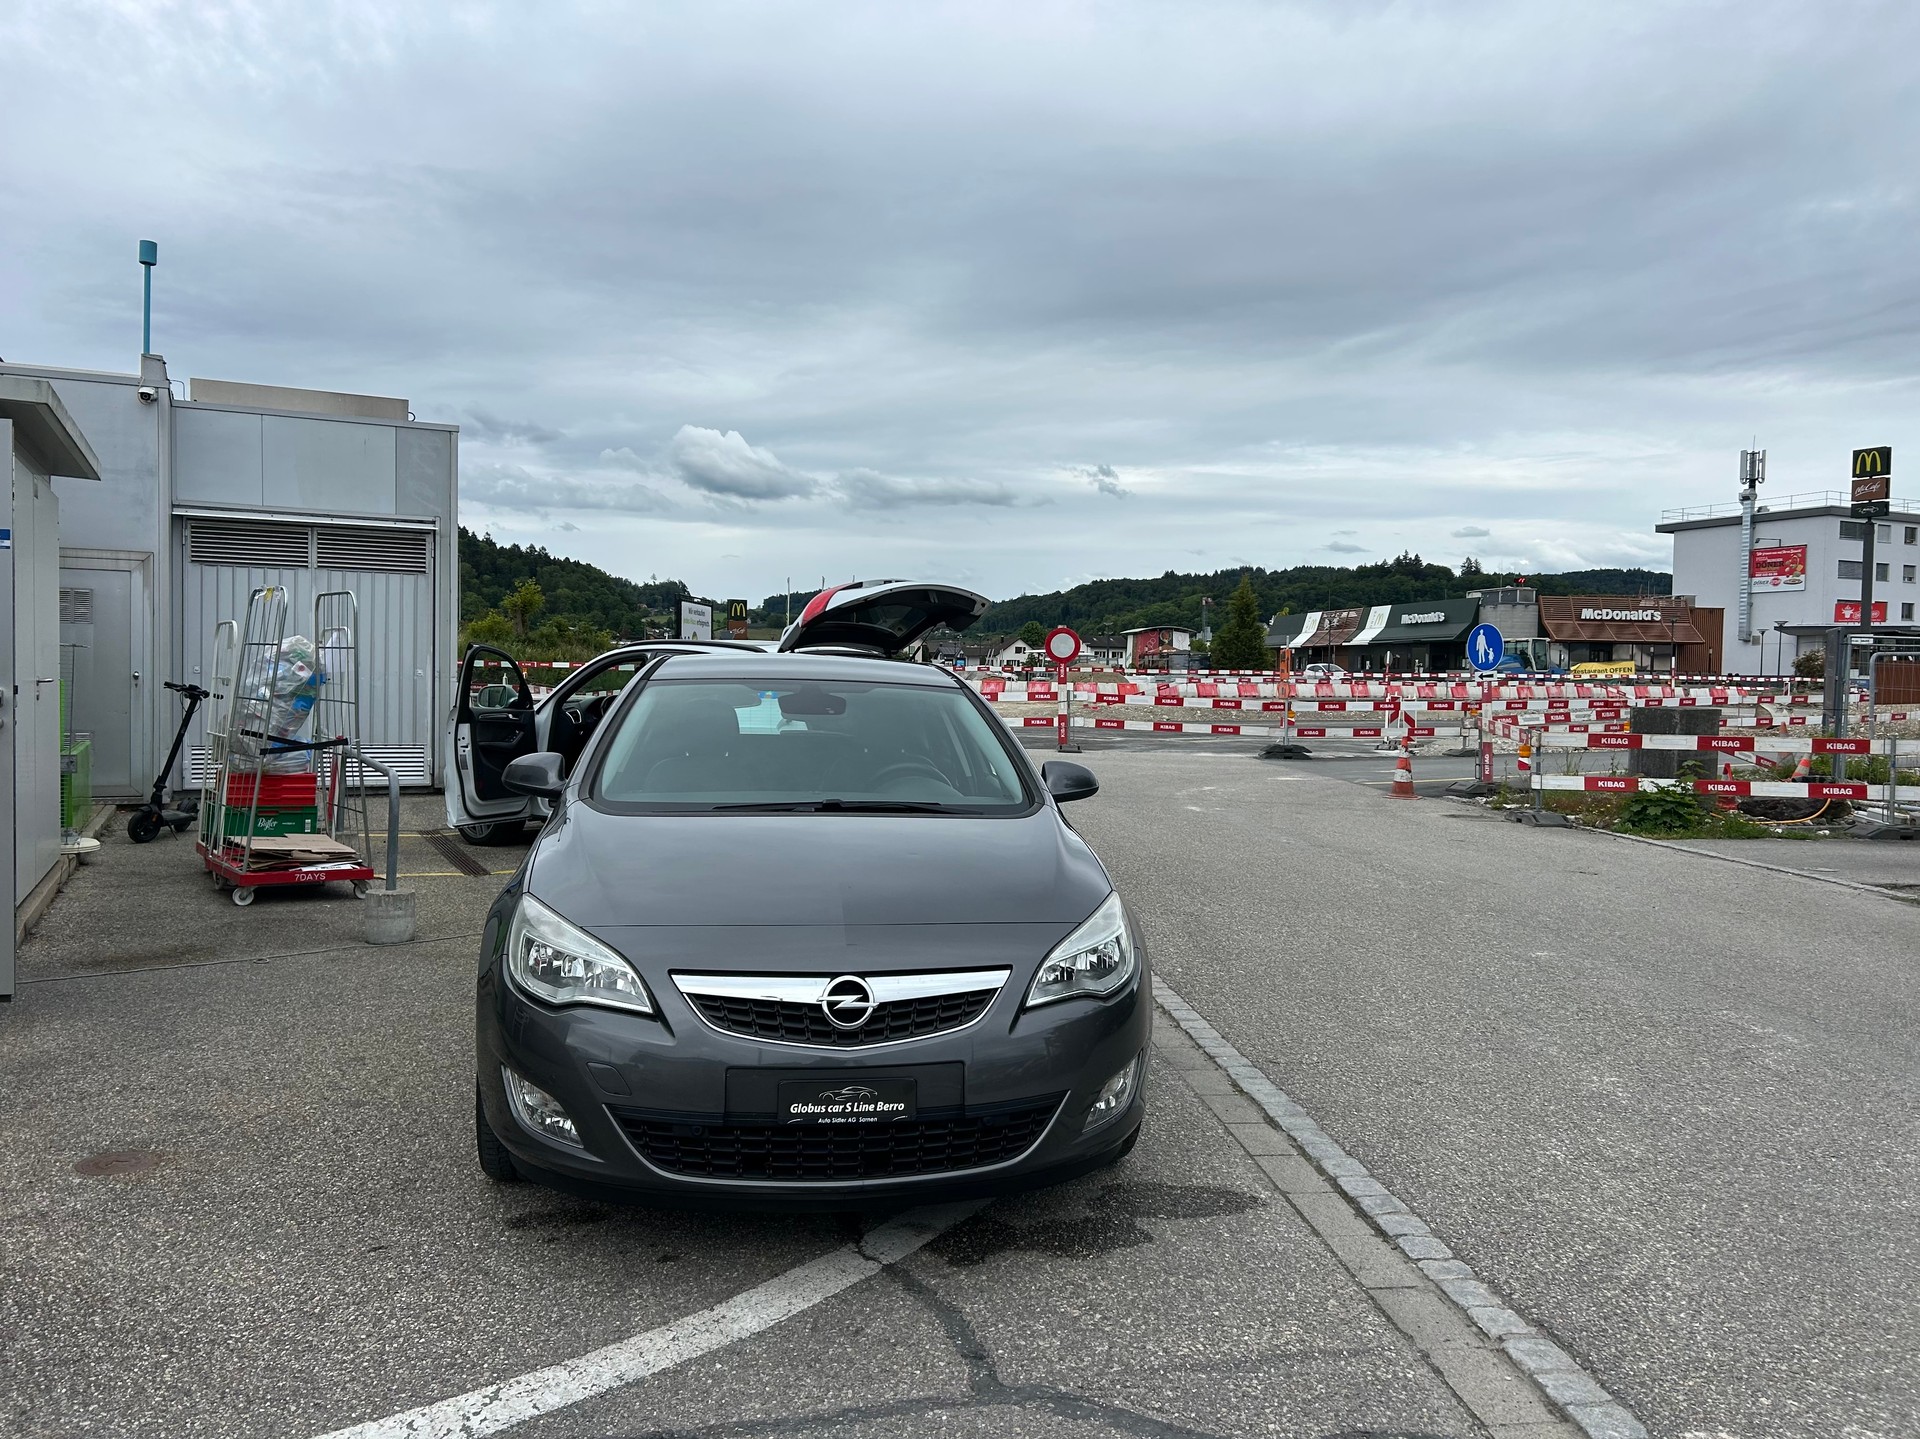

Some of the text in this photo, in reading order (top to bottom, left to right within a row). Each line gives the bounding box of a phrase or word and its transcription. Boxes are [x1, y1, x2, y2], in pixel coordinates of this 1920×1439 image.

[1401, 612, 1445, 624] McDonald's
[1581, 608, 1662, 621] McDonald's
[1708, 784, 1736, 792] KIBAG
[294, 873, 326, 881] 7DAYS
[790, 1102, 904, 1113] Globus car S Line Berro
